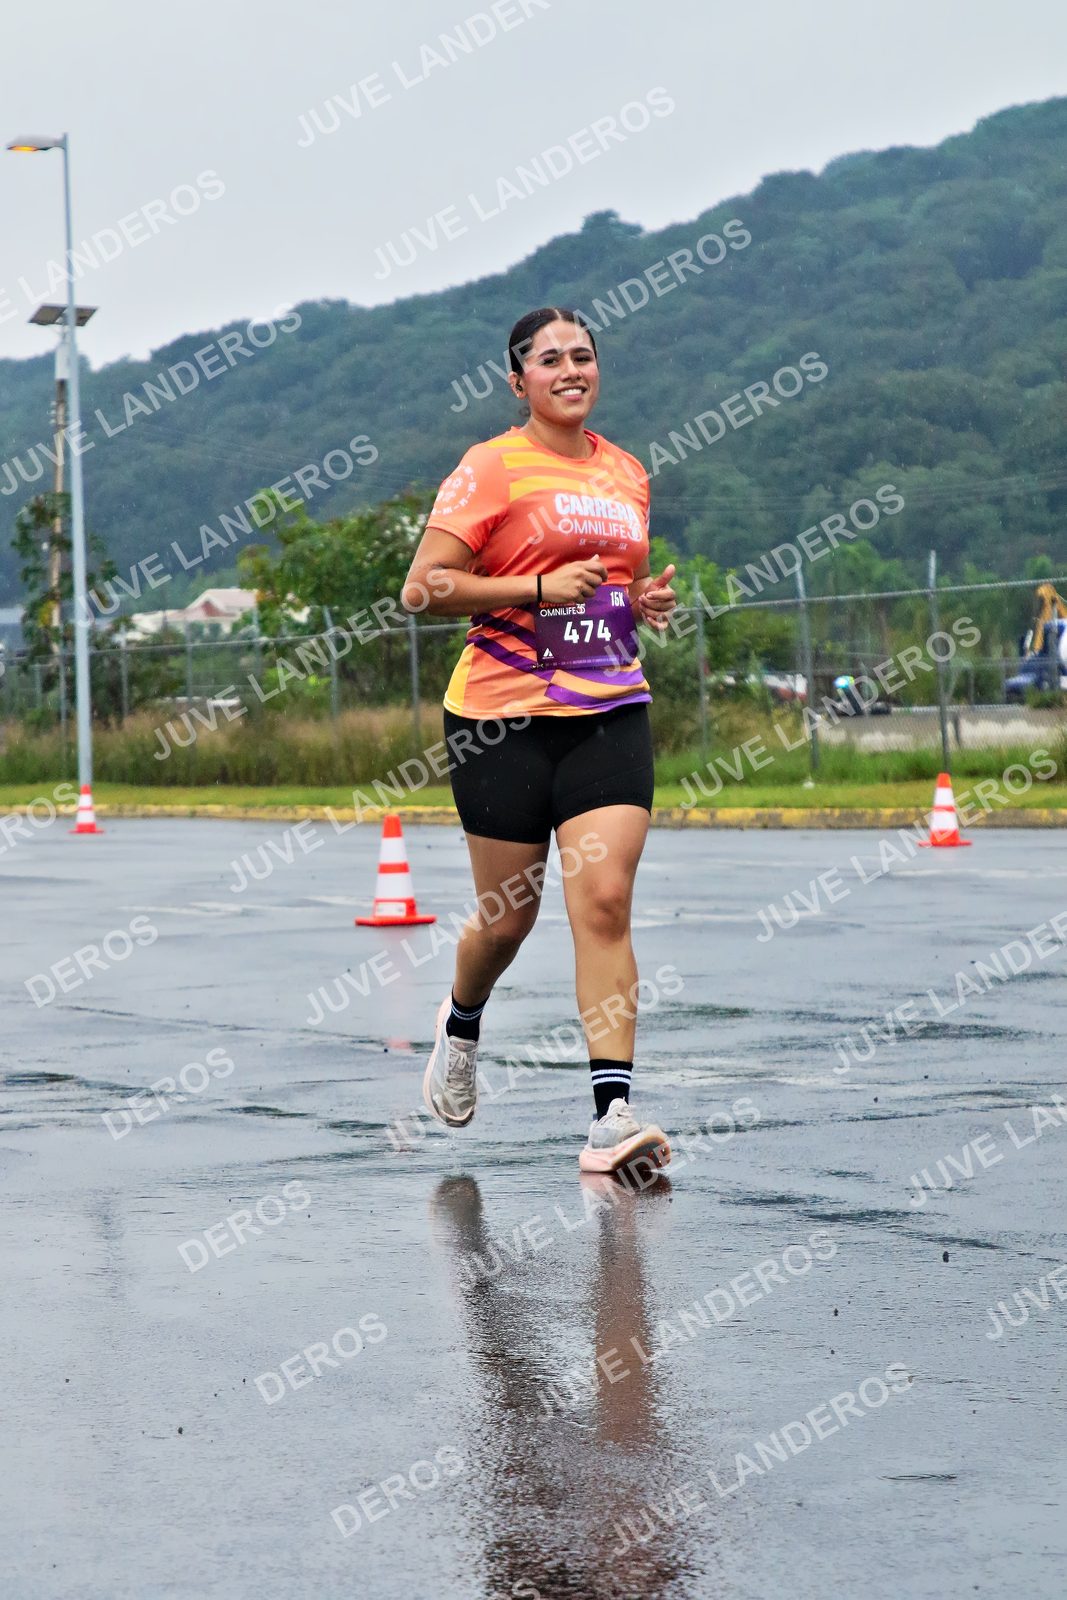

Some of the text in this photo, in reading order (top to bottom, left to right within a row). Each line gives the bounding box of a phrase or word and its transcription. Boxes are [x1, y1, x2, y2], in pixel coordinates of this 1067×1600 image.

[555, 493, 640, 522] CARRERA
[610, 591, 625, 607] 15K
[563, 619, 612, 644] 474
